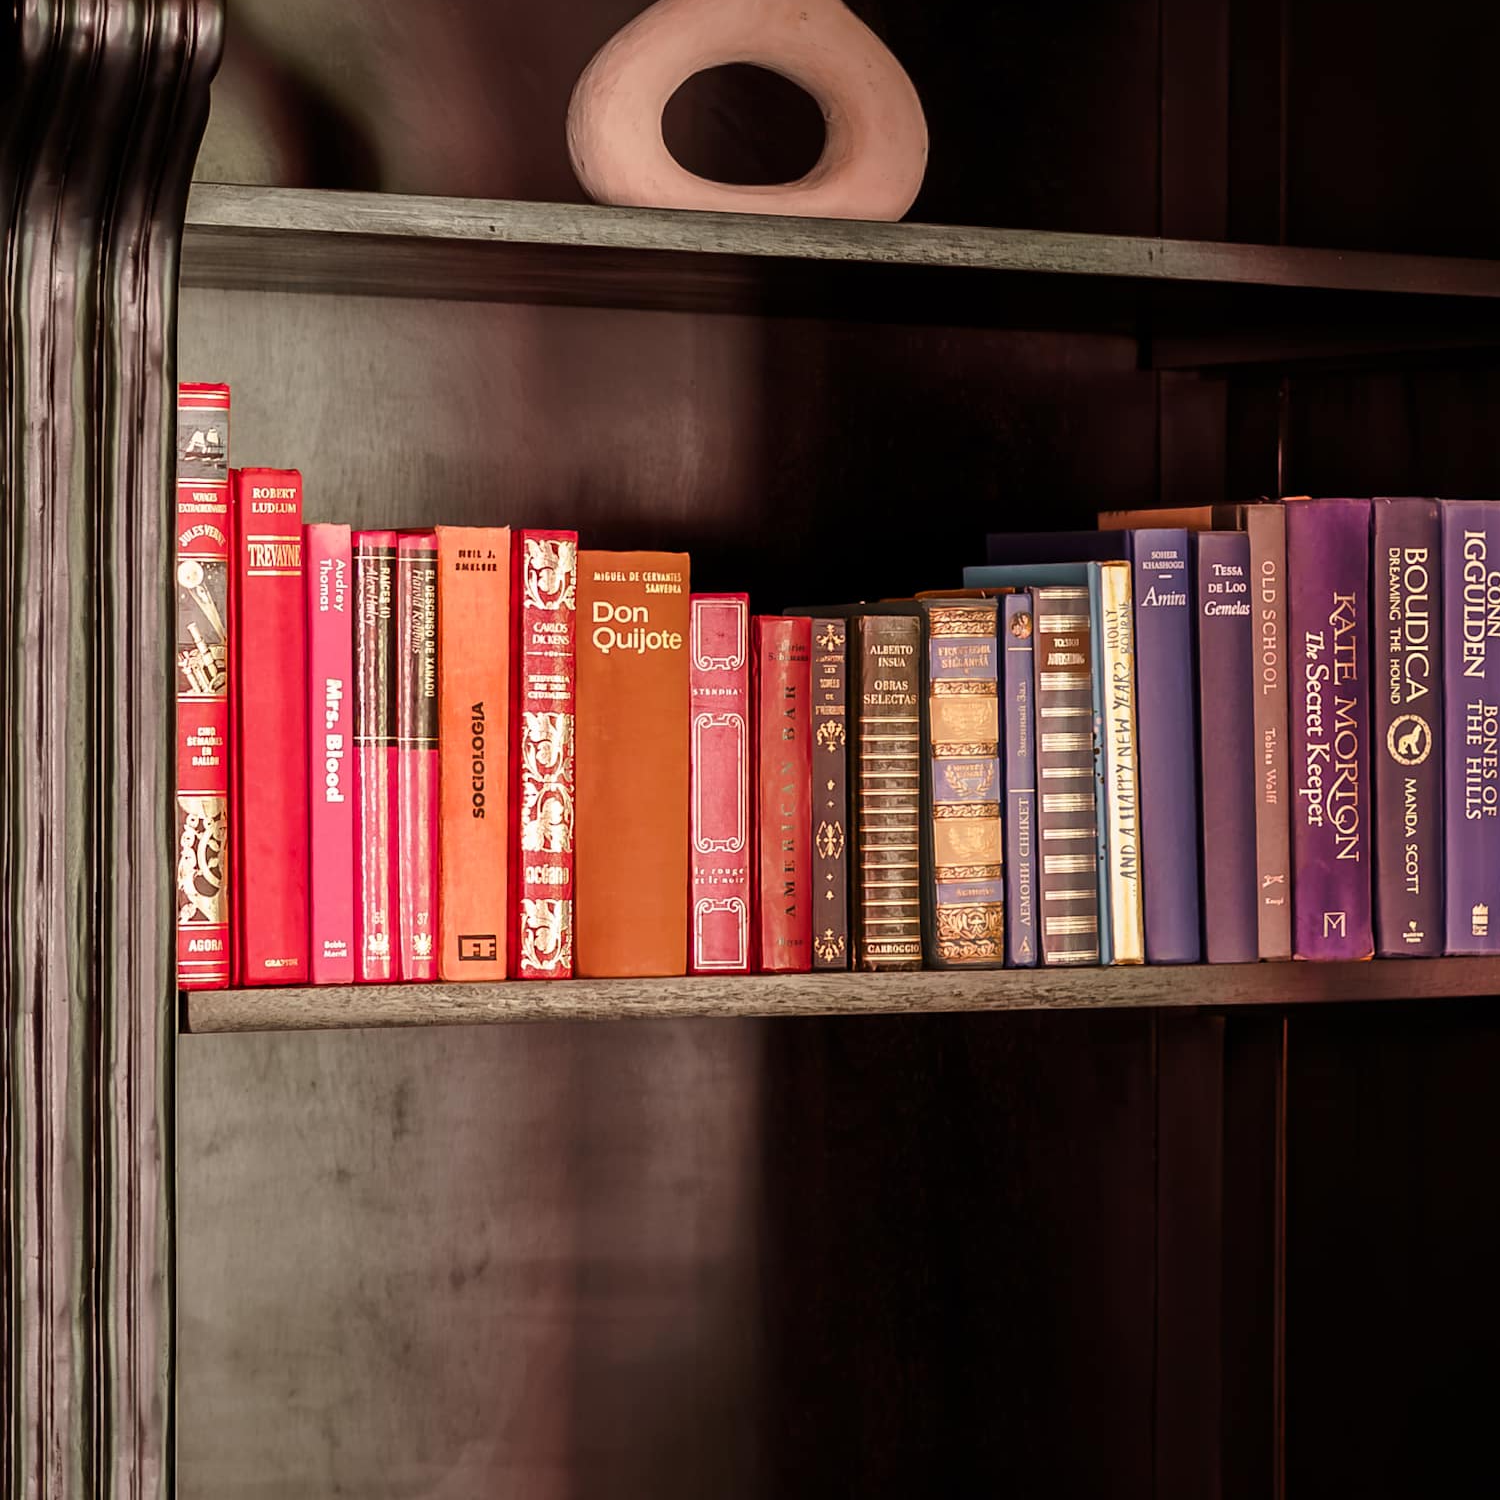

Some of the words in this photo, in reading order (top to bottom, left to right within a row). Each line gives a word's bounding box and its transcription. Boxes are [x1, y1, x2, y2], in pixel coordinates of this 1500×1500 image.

[252, 488, 297, 499] ROBERT
[252, 502, 297, 514] LUDLUM
[178, 523, 205, 548] JULES
[247, 544, 301, 567] TREVAYNE
[486, 550, 496, 559] J.
[1142, 561, 1185, 570] KHASHOGGI
[1151, 550, 1178, 560] SOHEIR
[319, 558, 333, 612] Thomas
[333, 558, 348, 612] Audrey
[412, 569, 425, 607] Harold
[424, 569, 435, 582] EL
[593, 571, 627, 582] MIGUEL
[629, 571, 640, 582] DE
[642, 571, 682, 582] CERVANTES
[645, 583, 682, 594] SAAVEDRA
[1261, 560, 1276, 604] OLD
[1388, 547, 1401, 621] DREAMING
[424, 585, 435, 638] DESCENSO
[592, 601, 649, 623] Don
[1140, 586, 1186, 607] Amira
[1204, 600, 1251, 616] Gemelas
[1463, 530, 1487, 679] IGGULDEN
[411, 609, 425, 655] Robbins
[532, 634, 570, 645] DICKENS
[533, 621, 568, 633] CARLOS
[592, 627, 682, 654] Quijote
[1105, 609, 1120, 650] HOLLY
[1329, 591, 1358, 686] KATE
[1389, 627, 1401, 653] THE
[1404, 547, 1430, 704] BOUDICA
[424, 641, 435, 654] DE
[869, 645, 913, 655] ALBERTO
[877, 657, 906, 668] INSUA
[1262, 609, 1278, 695] SCHOOL
[1305, 631, 1325, 661] The
[863, 694, 917, 705] SELECTAS
[874, 680, 909, 691] OBRAS
[1112, 661, 1131, 710] YEAR?
[1305, 663, 1330, 737] Secret
[1389, 659, 1401, 705] HOUND
[325, 678, 343, 729] Mrs.
[781, 685, 797, 741] BAR
[1114, 718, 1133, 757] NEW
[1466, 699, 1483, 746] THE
[471, 701, 485, 819] SOCIOLOGIA
[1264, 727, 1277, 766] Tobias
[1482, 704, 1499, 780] BONES
[325, 734, 345, 803] Blood
[1265, 768, 1278, 805] Wolff
[1299, 742, 1331, 828] Keeper
[1326, 695, 1360, 863] MORTON
[1116, 764, 1136, 822] HAPPY
[1465, 757, 1482, 821] HILLS
[1481, 786, 1498, 817] OF
[1404, 778, 1419, 838] MANDA
[780, 760, 797, 917] AMERICAN
[1018, 797, 1030, 857] СНИКЕТ
[1118, 827, 1135, 838] A
[525, 863, 570, 885] océano
[695, 867, 705, 875] le
[711, 868, 745, 876] rouge
[708, 876, 718, 884] le
[721, 876, 745, 884] noir
[1405, 843, 1420, 895] SCOTT
[1018, 862, 1031, 927] ЛЕМОНИ
[416, 912, 429, 925] 37
[188, 939, 223, 952] AGORA
[867, 943, 920, 954] CARROGGIO
